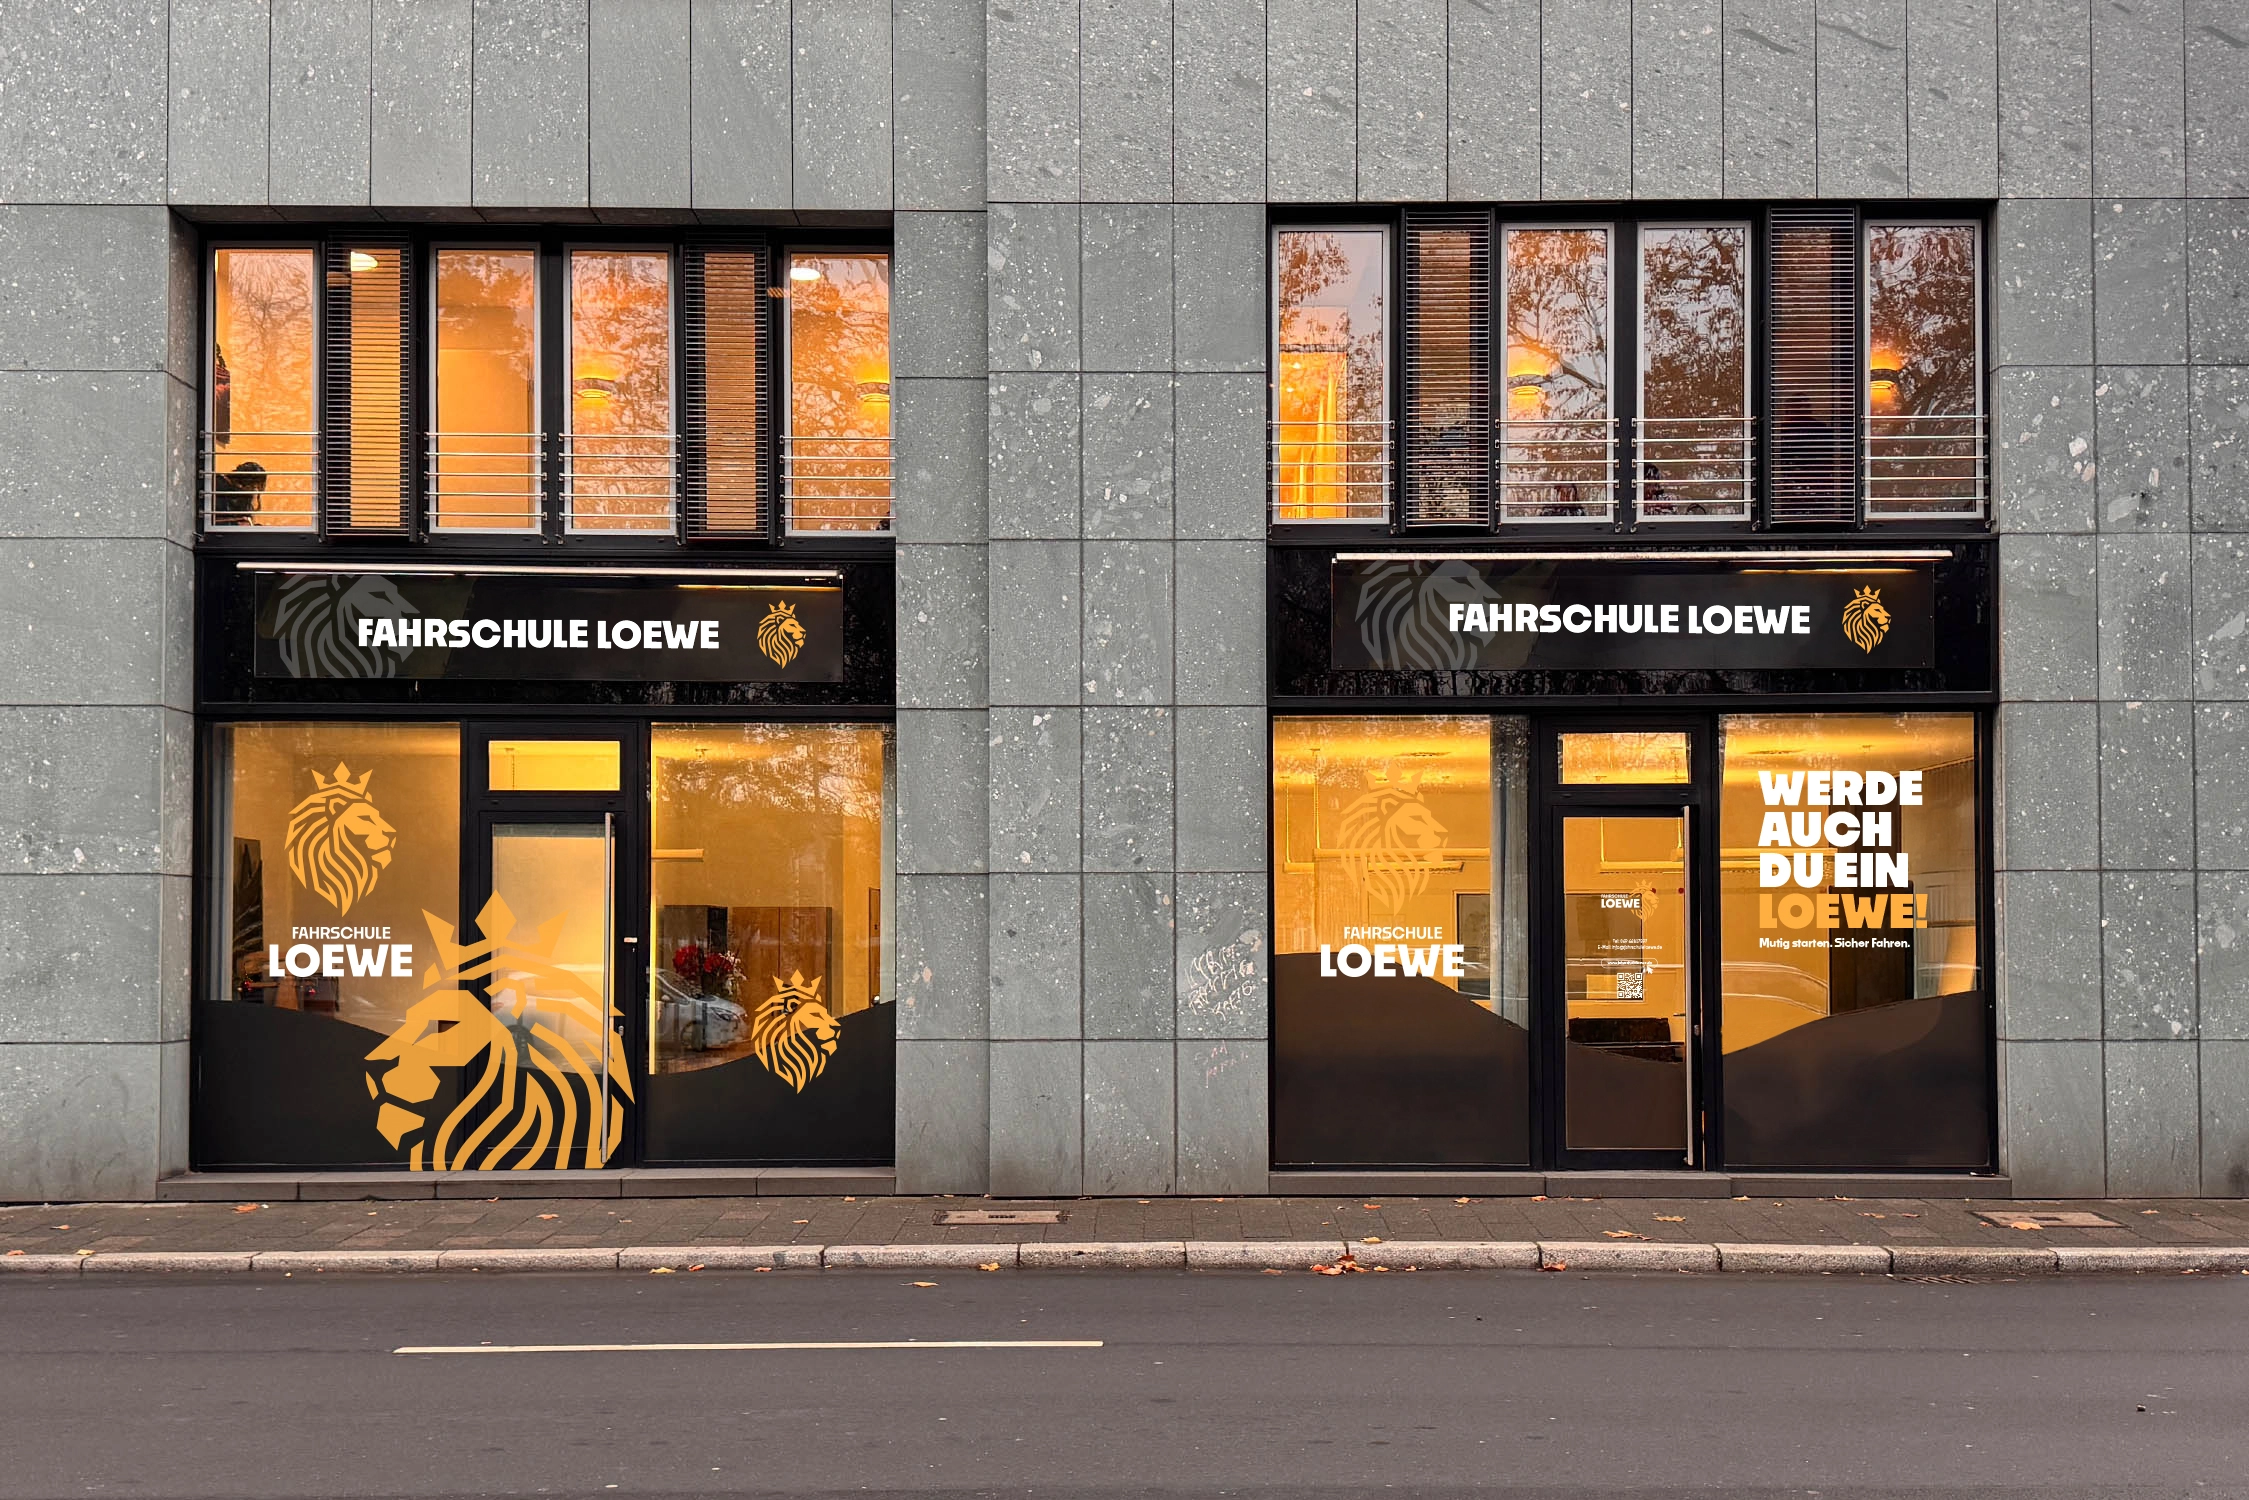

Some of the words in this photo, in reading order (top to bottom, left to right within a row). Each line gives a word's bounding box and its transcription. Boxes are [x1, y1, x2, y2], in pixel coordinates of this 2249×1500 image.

[358, 618, 589, 648] FAHRSCHULE
[597, 620, 720, 650] LOEWE
[1449, 603, 1680, 634] FAHRSCHULE
[1689, 605, 1811, 635] LOEWE
[1757, 770, 1923, 806] WERDE
[1757, 811, 1892, 847] AUCH
[1759, 852, 1824, 888] DU
[1834, 852, 1909, 888] EIN
[1600, 898, 1641, 909] LOEWE
[1759, 893, 1928, 929] LOEWE!
[291, 926, 391, 940] FAHRSCHULE
[1343, 926, 1443, 940] FAHRSCHULE
[1759, 937, 1790, 949] Mutig
[1791, 938, 1833, 948] starten.
[1834, 937, 1870, 948] Sicher
[1871, 937, 1911, 948] Fahren.
[269, 943, 413, 978] LOEWE
[1320, 943, 1465, 978] LOEWE
